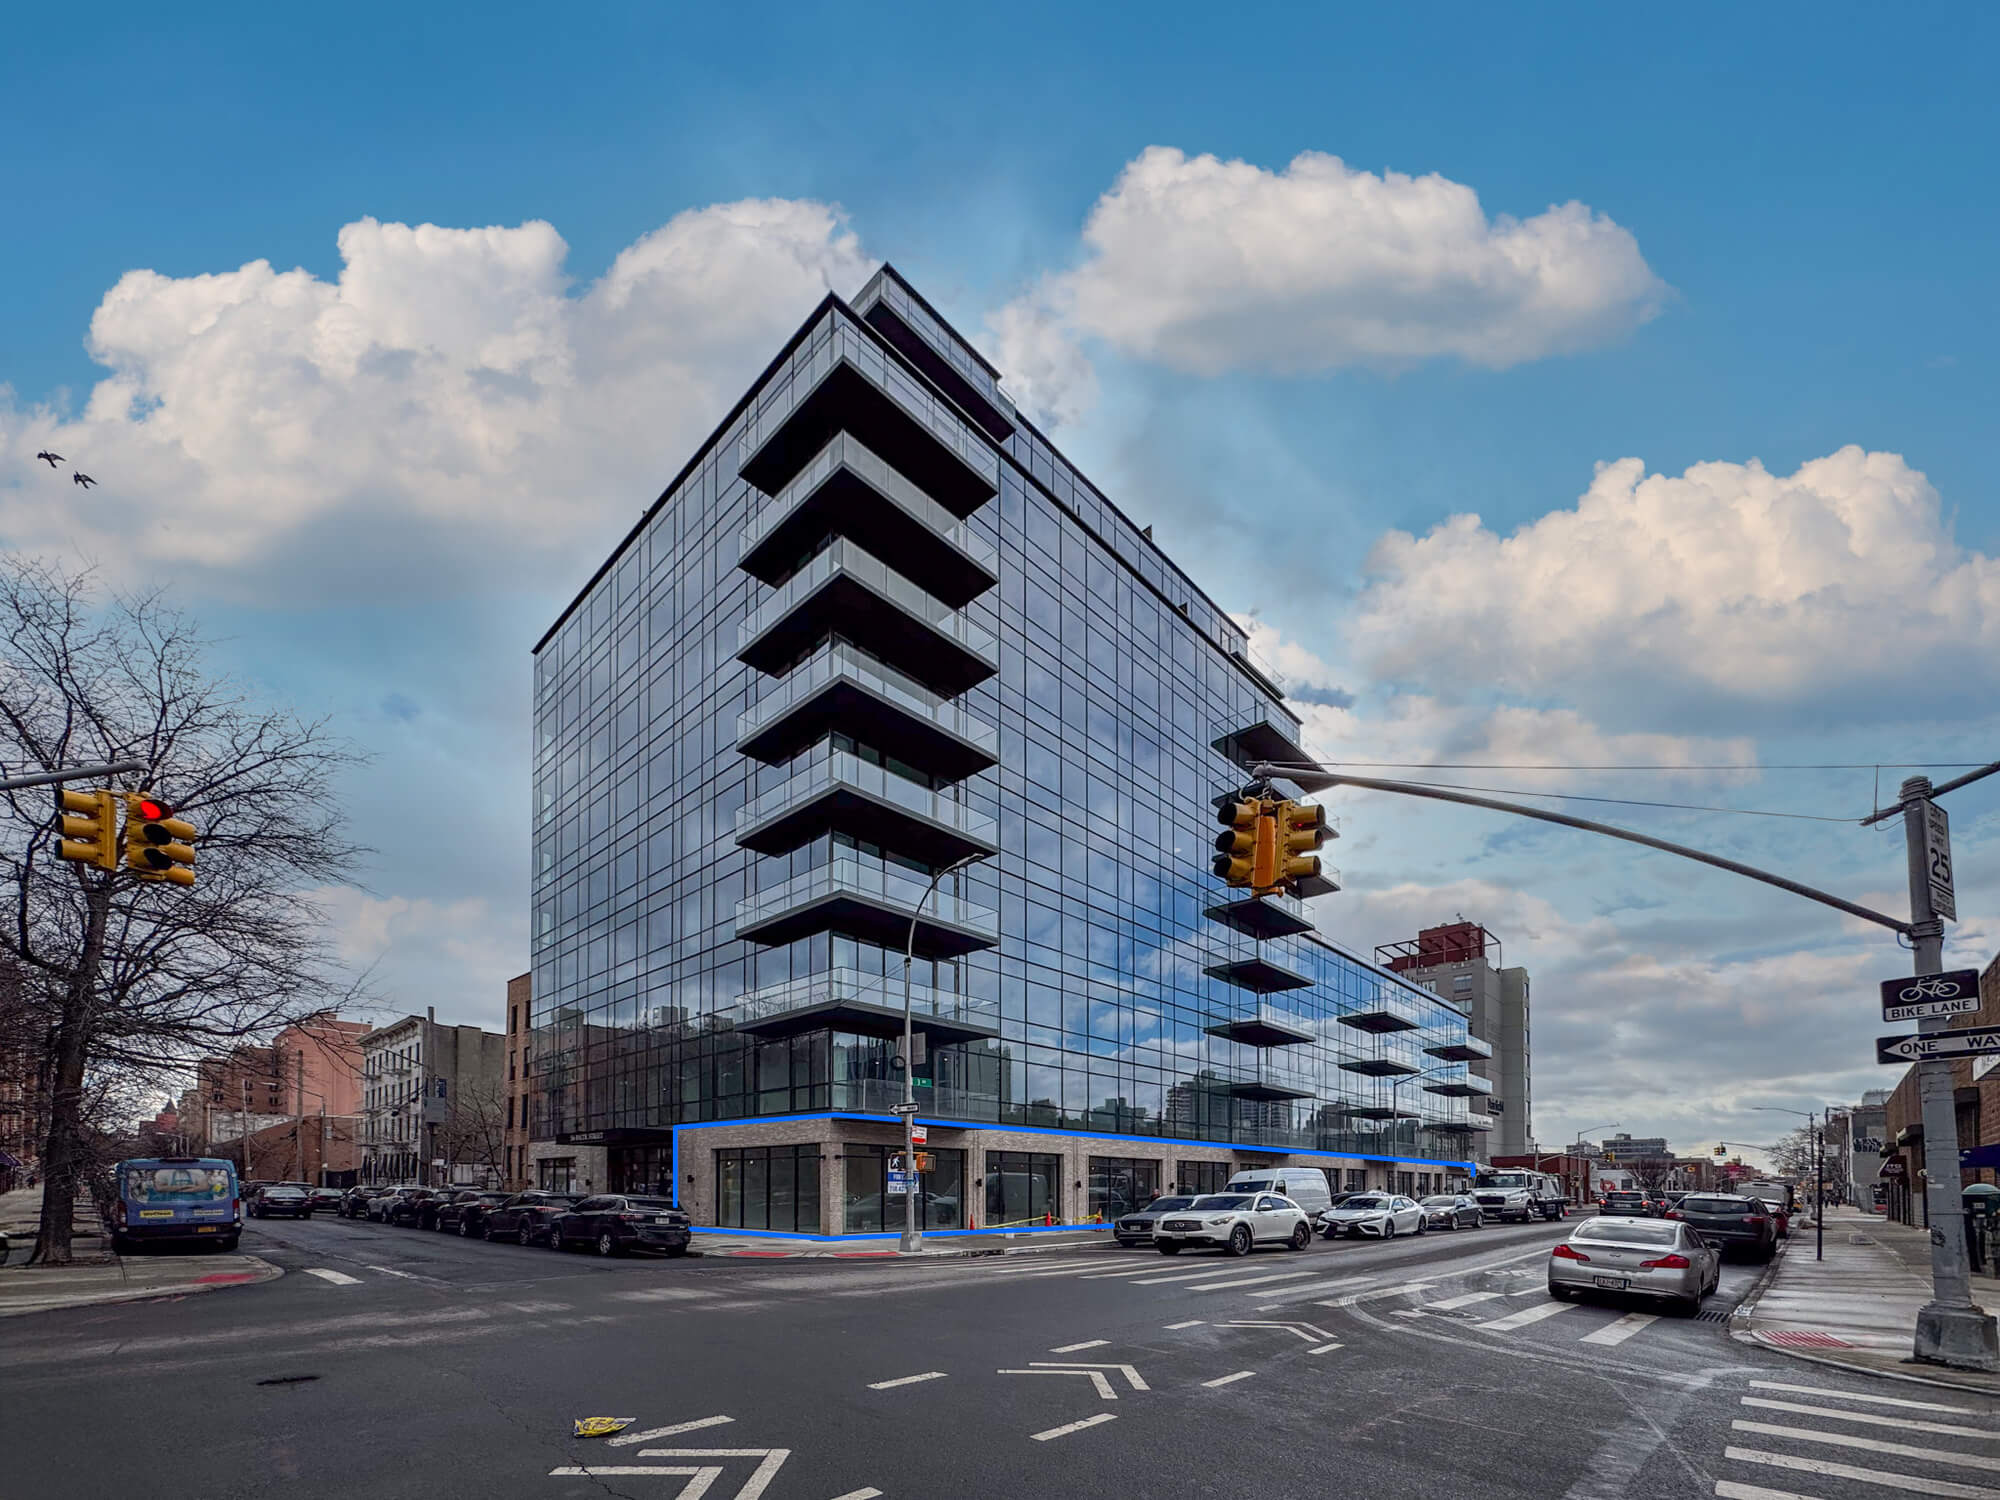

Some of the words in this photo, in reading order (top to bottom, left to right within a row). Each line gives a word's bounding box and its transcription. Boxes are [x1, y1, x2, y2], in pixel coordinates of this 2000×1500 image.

[1930, 847, 1950, 883] 25
[1891, 1006, 1925, 1019] BIKE
[1931, 1000, 1972, 1013] LANE
[1900, 1041, 1939, 1054] ONE
